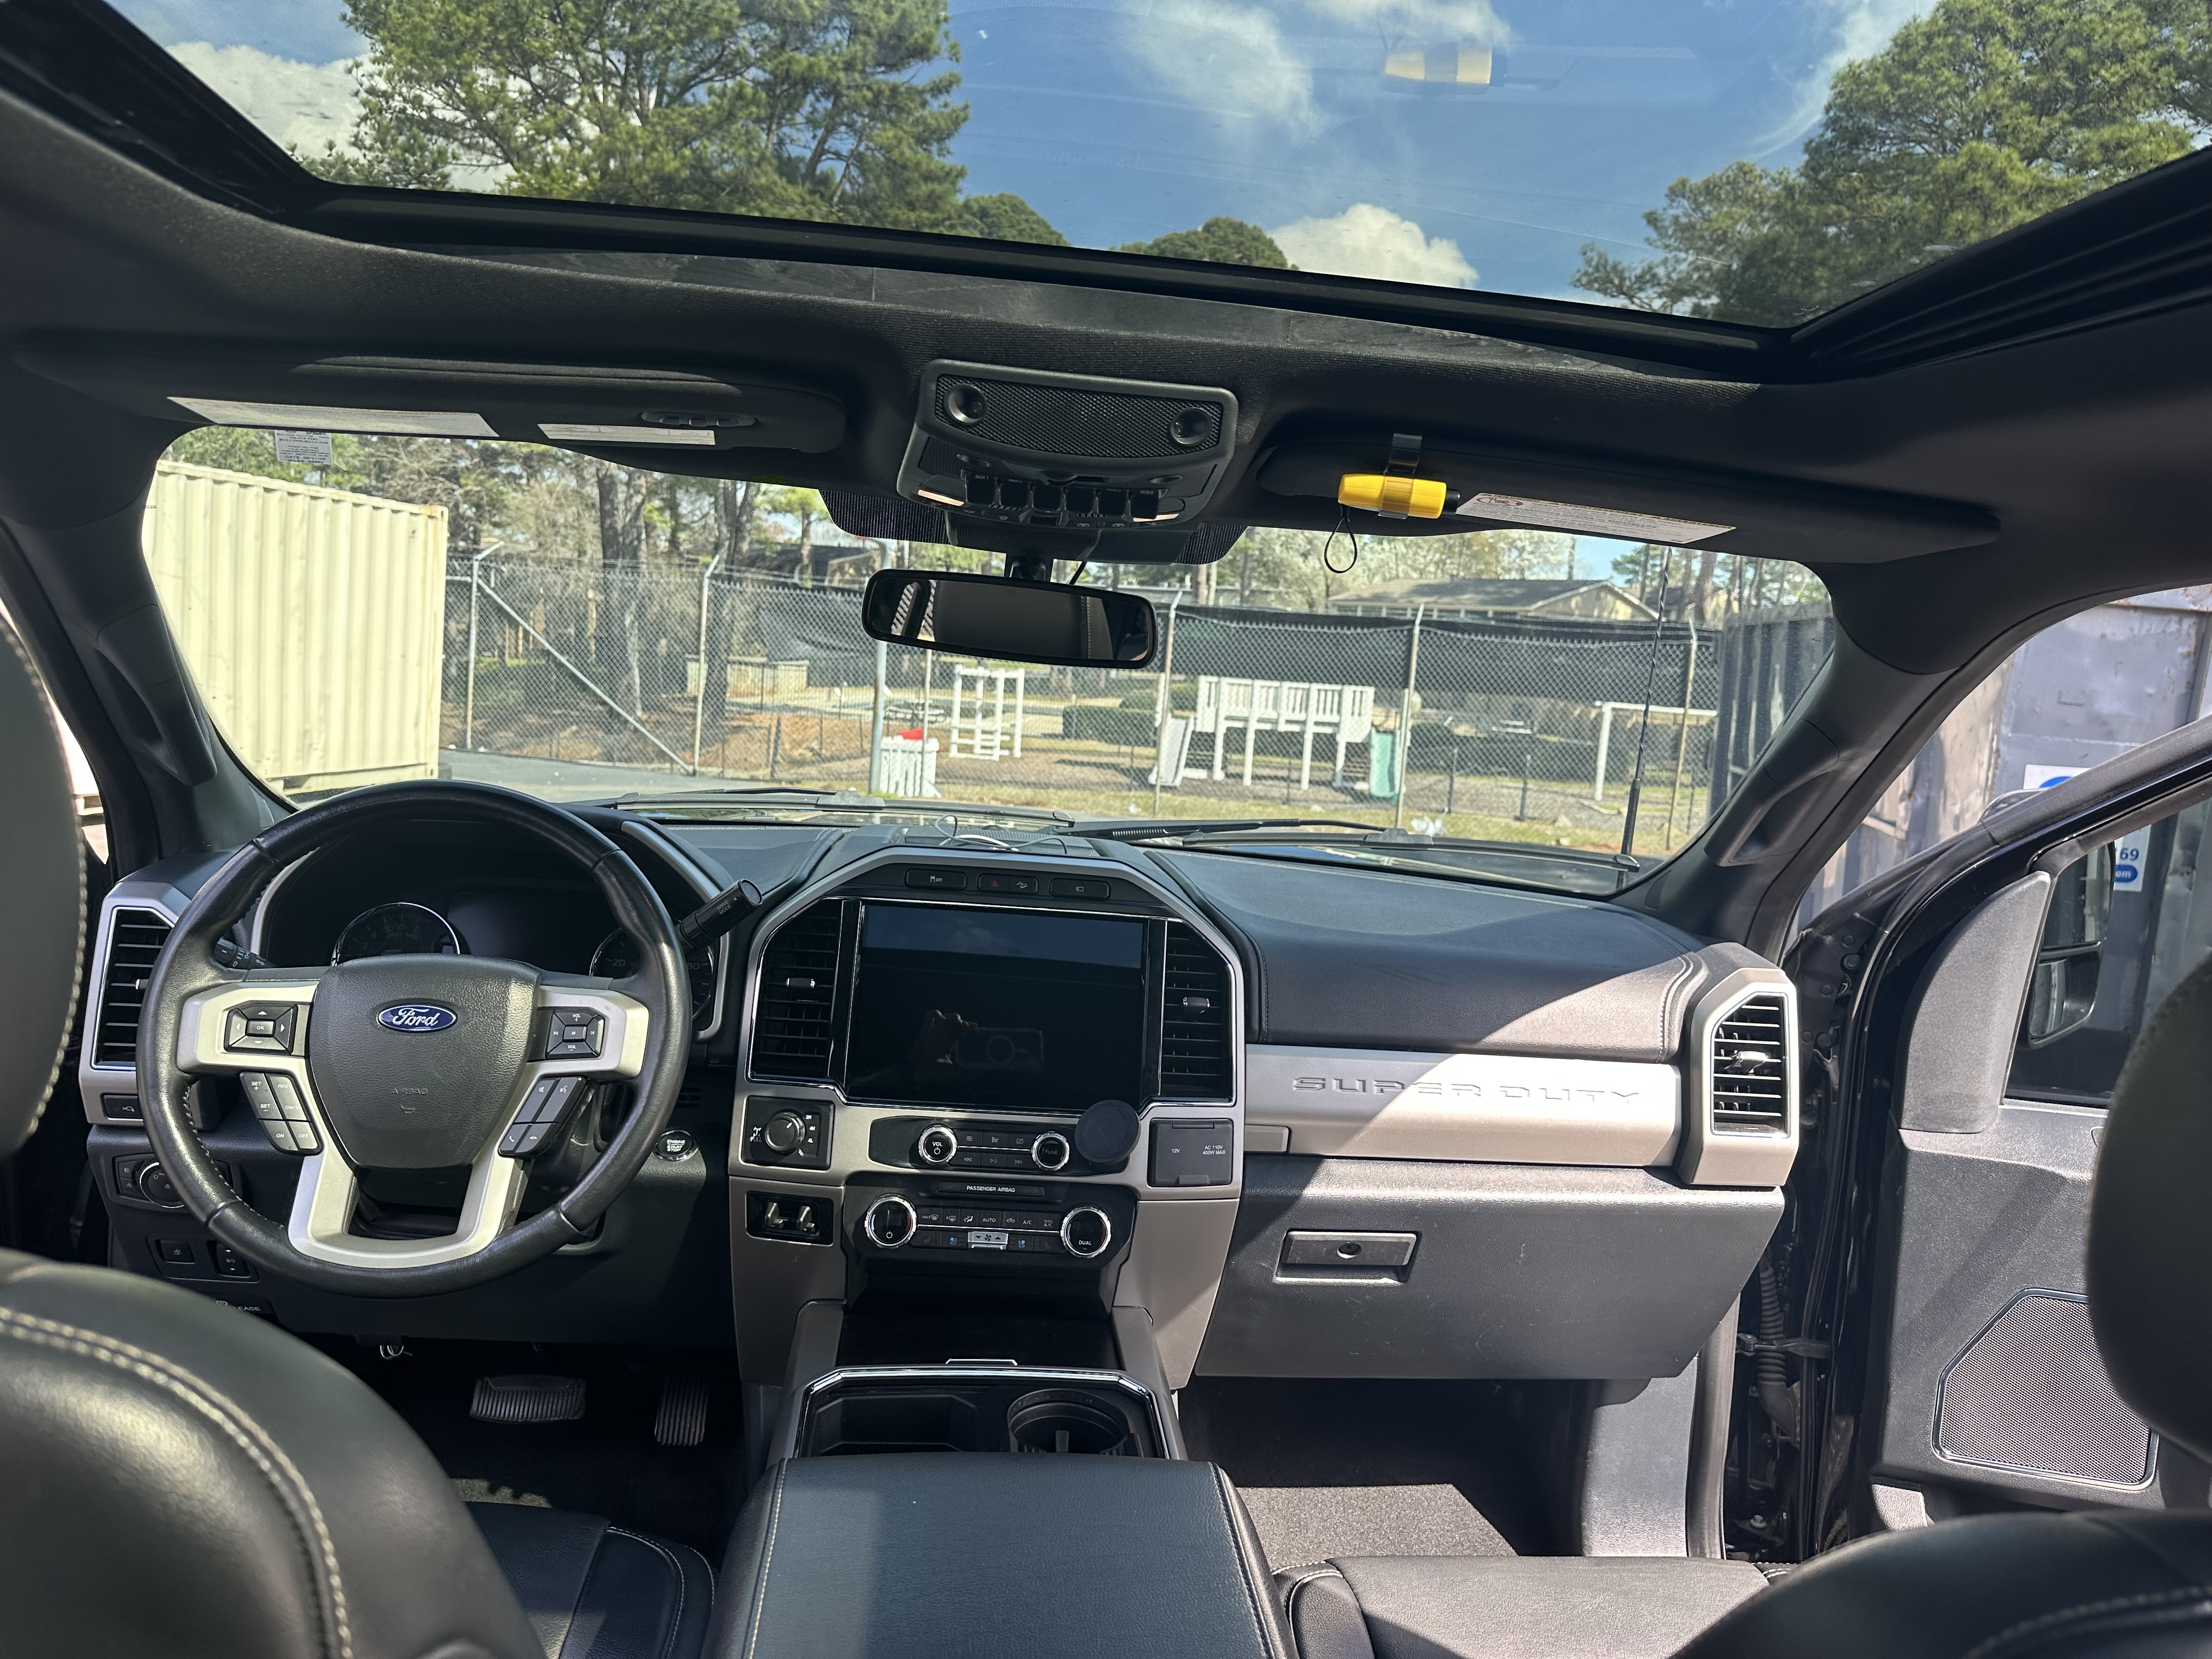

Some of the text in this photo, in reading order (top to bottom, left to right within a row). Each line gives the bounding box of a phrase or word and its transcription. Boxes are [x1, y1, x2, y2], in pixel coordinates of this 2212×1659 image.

[2120, 847, 2139, 861] 69
[716, 900, 729, 911] DRIVE
[718, 904, 732, 915] MODE
[393, 1008, 440, 1026] Ford
[1293, 1077, 1639, 1103] SUPER DUTY
